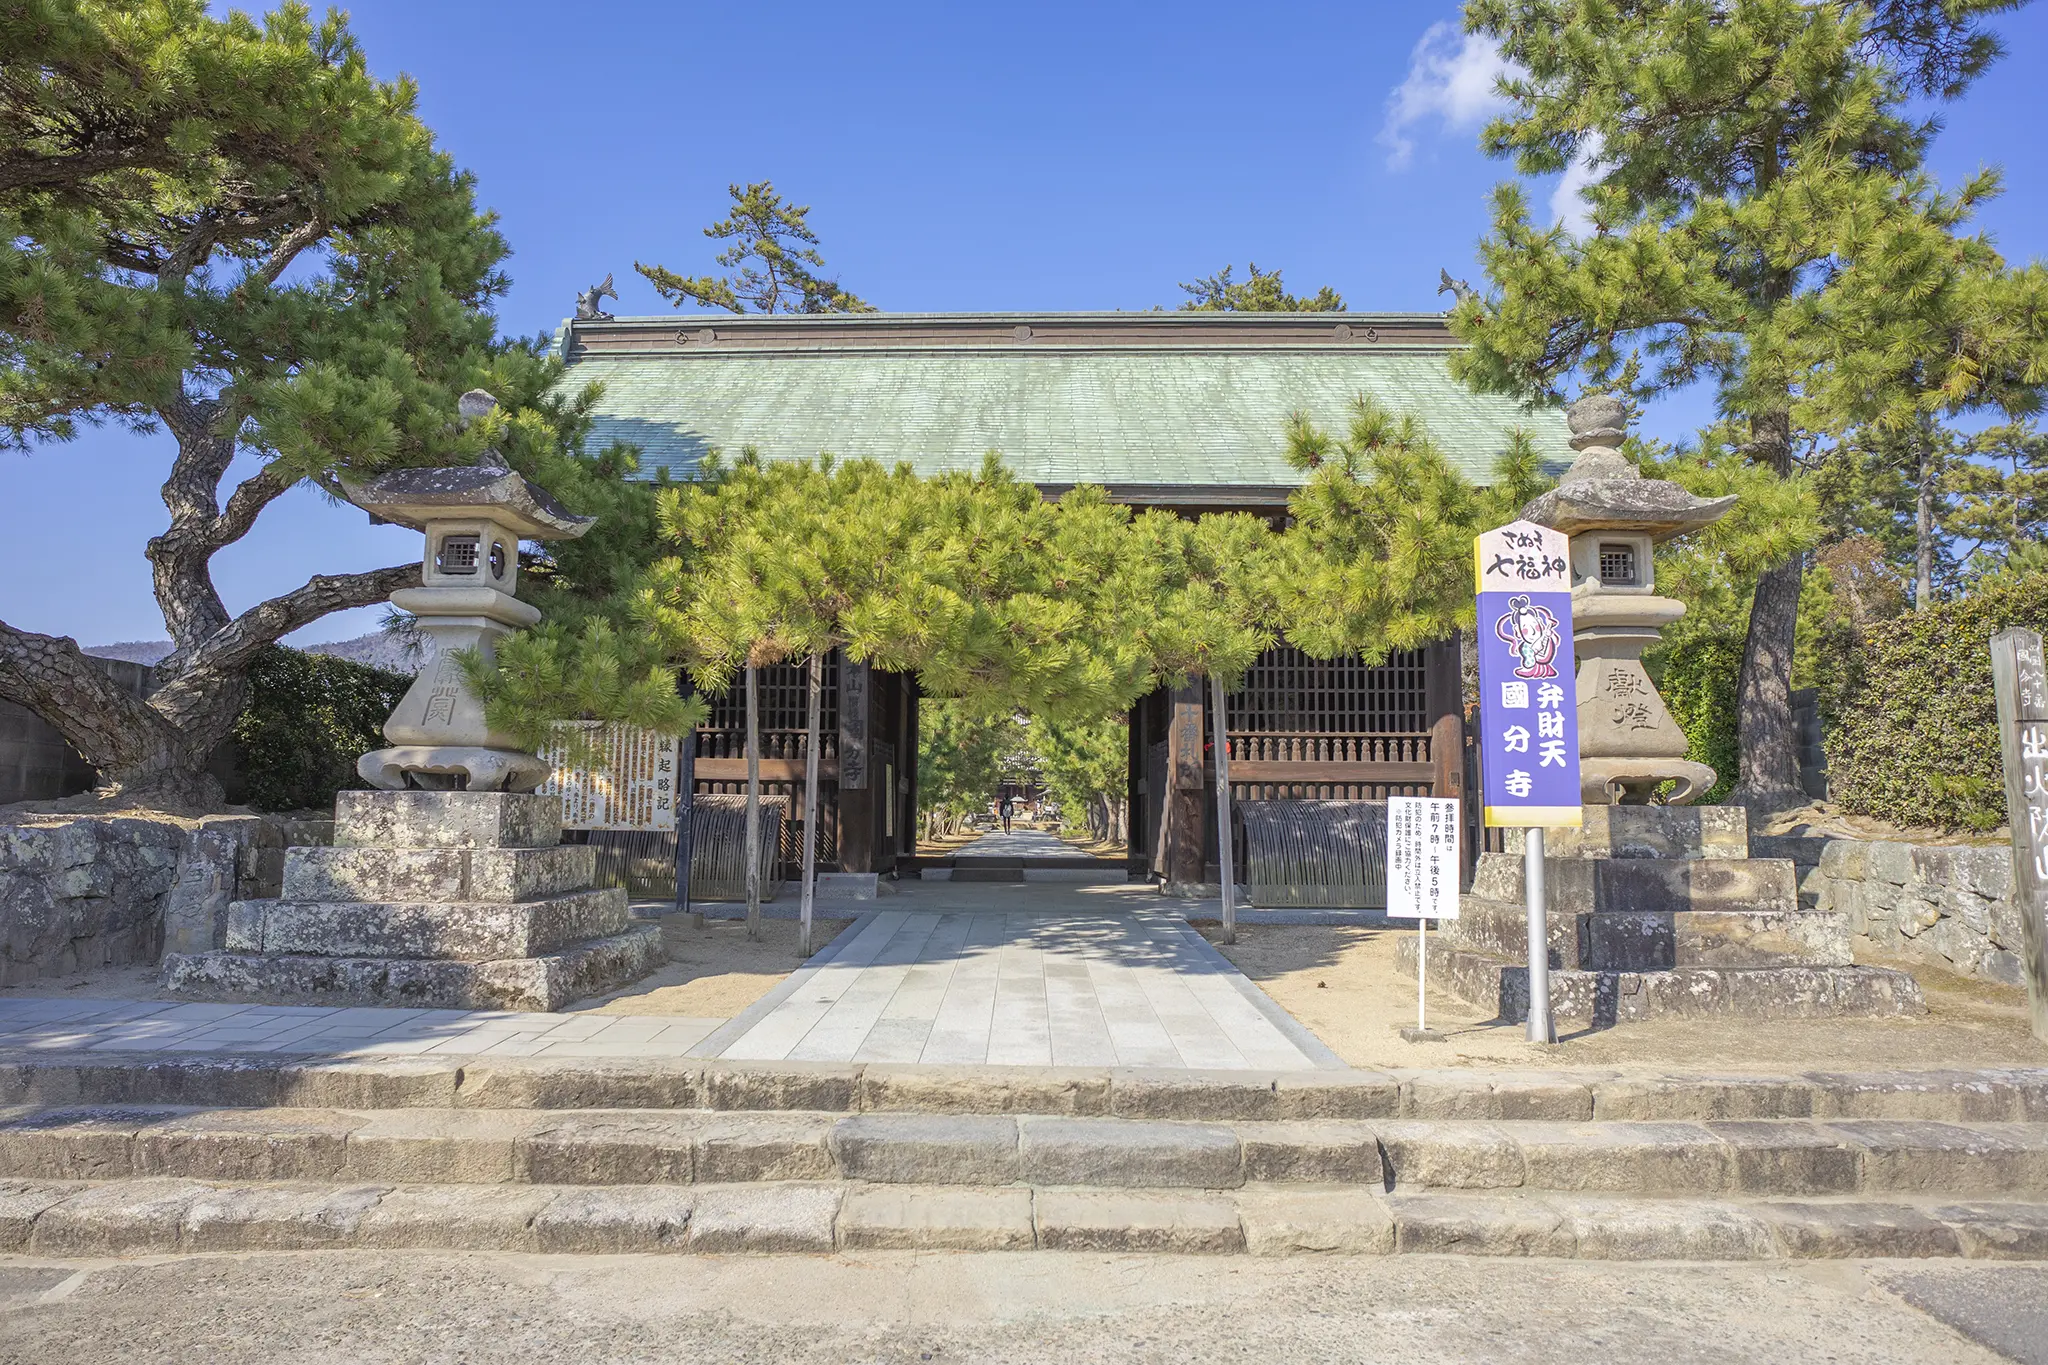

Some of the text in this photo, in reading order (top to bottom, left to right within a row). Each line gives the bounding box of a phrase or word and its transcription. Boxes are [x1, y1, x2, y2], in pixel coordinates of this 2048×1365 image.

[1486, 554, 1567, 580] 七福神
[1502, 530, 1543, 551] さぬき
[1501, 681, 1532, 798] 國分寺
[1536, 681, 1567, 768] 弁財天
